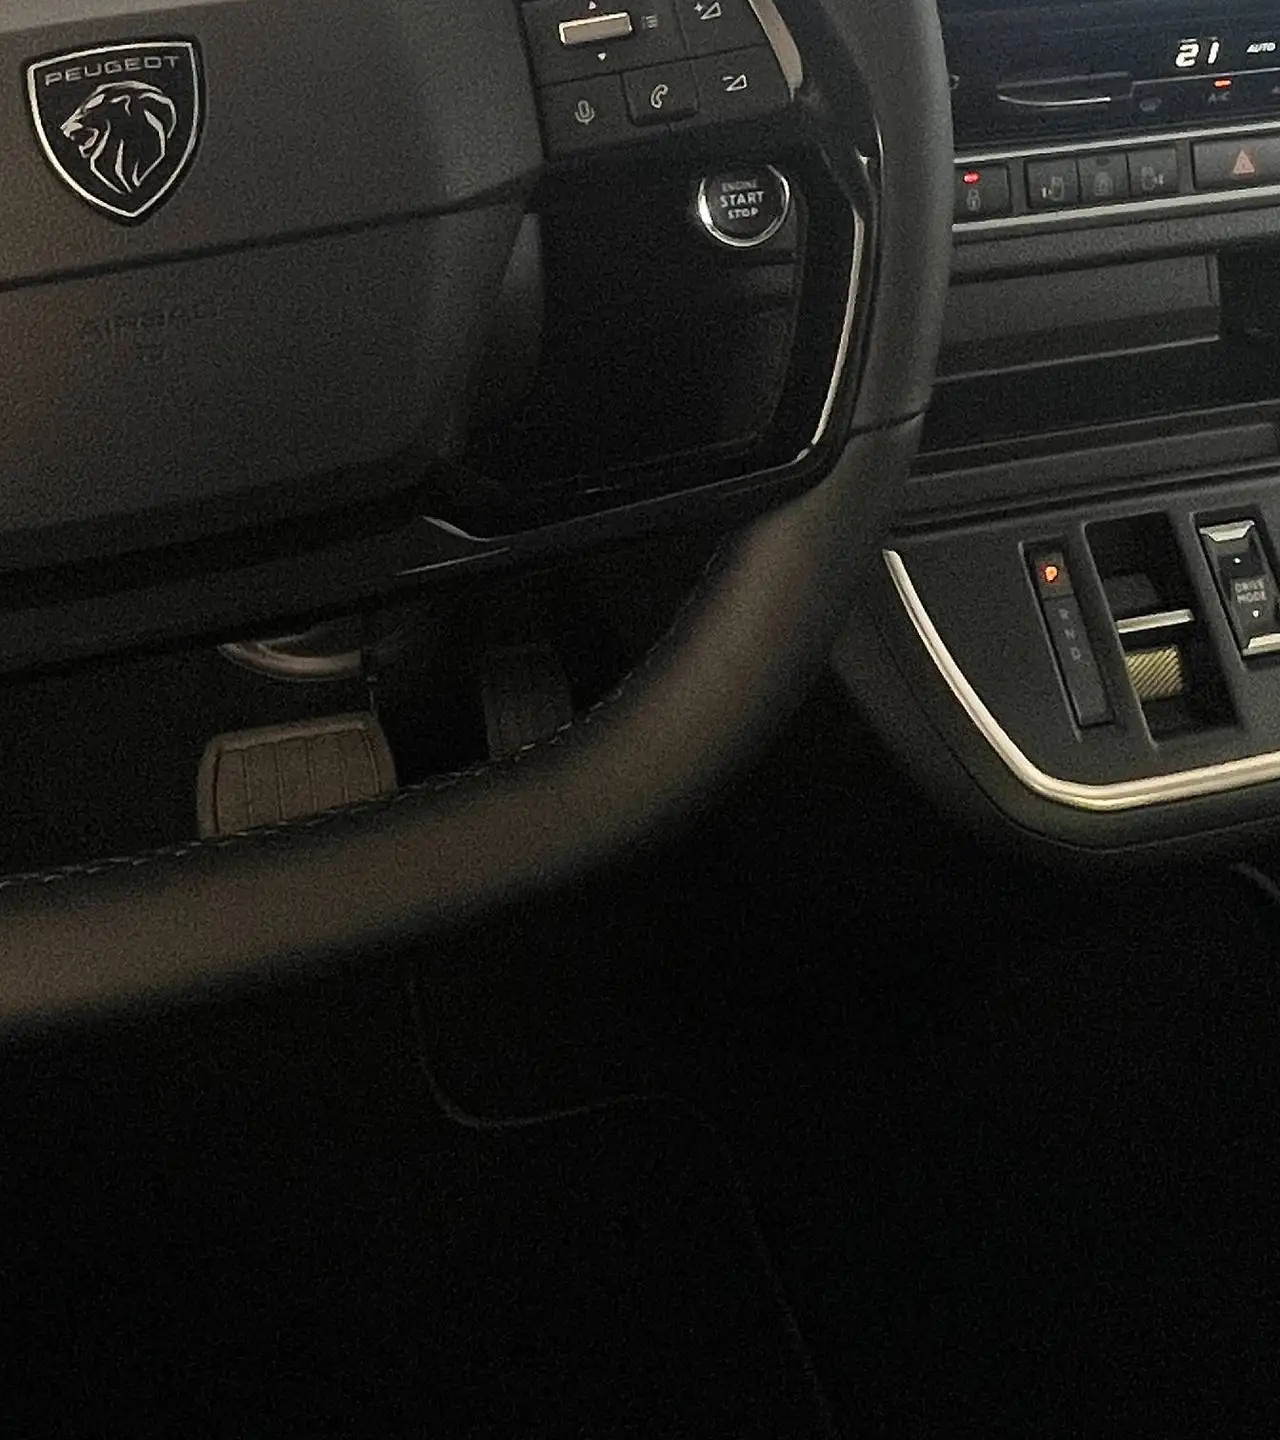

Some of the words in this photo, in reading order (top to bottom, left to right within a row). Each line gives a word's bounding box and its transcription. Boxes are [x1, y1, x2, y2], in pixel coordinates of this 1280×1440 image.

[1175, 41, 1220, 67] 21
[45, 56, 180, 86] PEUGEOT
[720, 191, 764, 208] START
[728, 207, 759, 220] STOP
